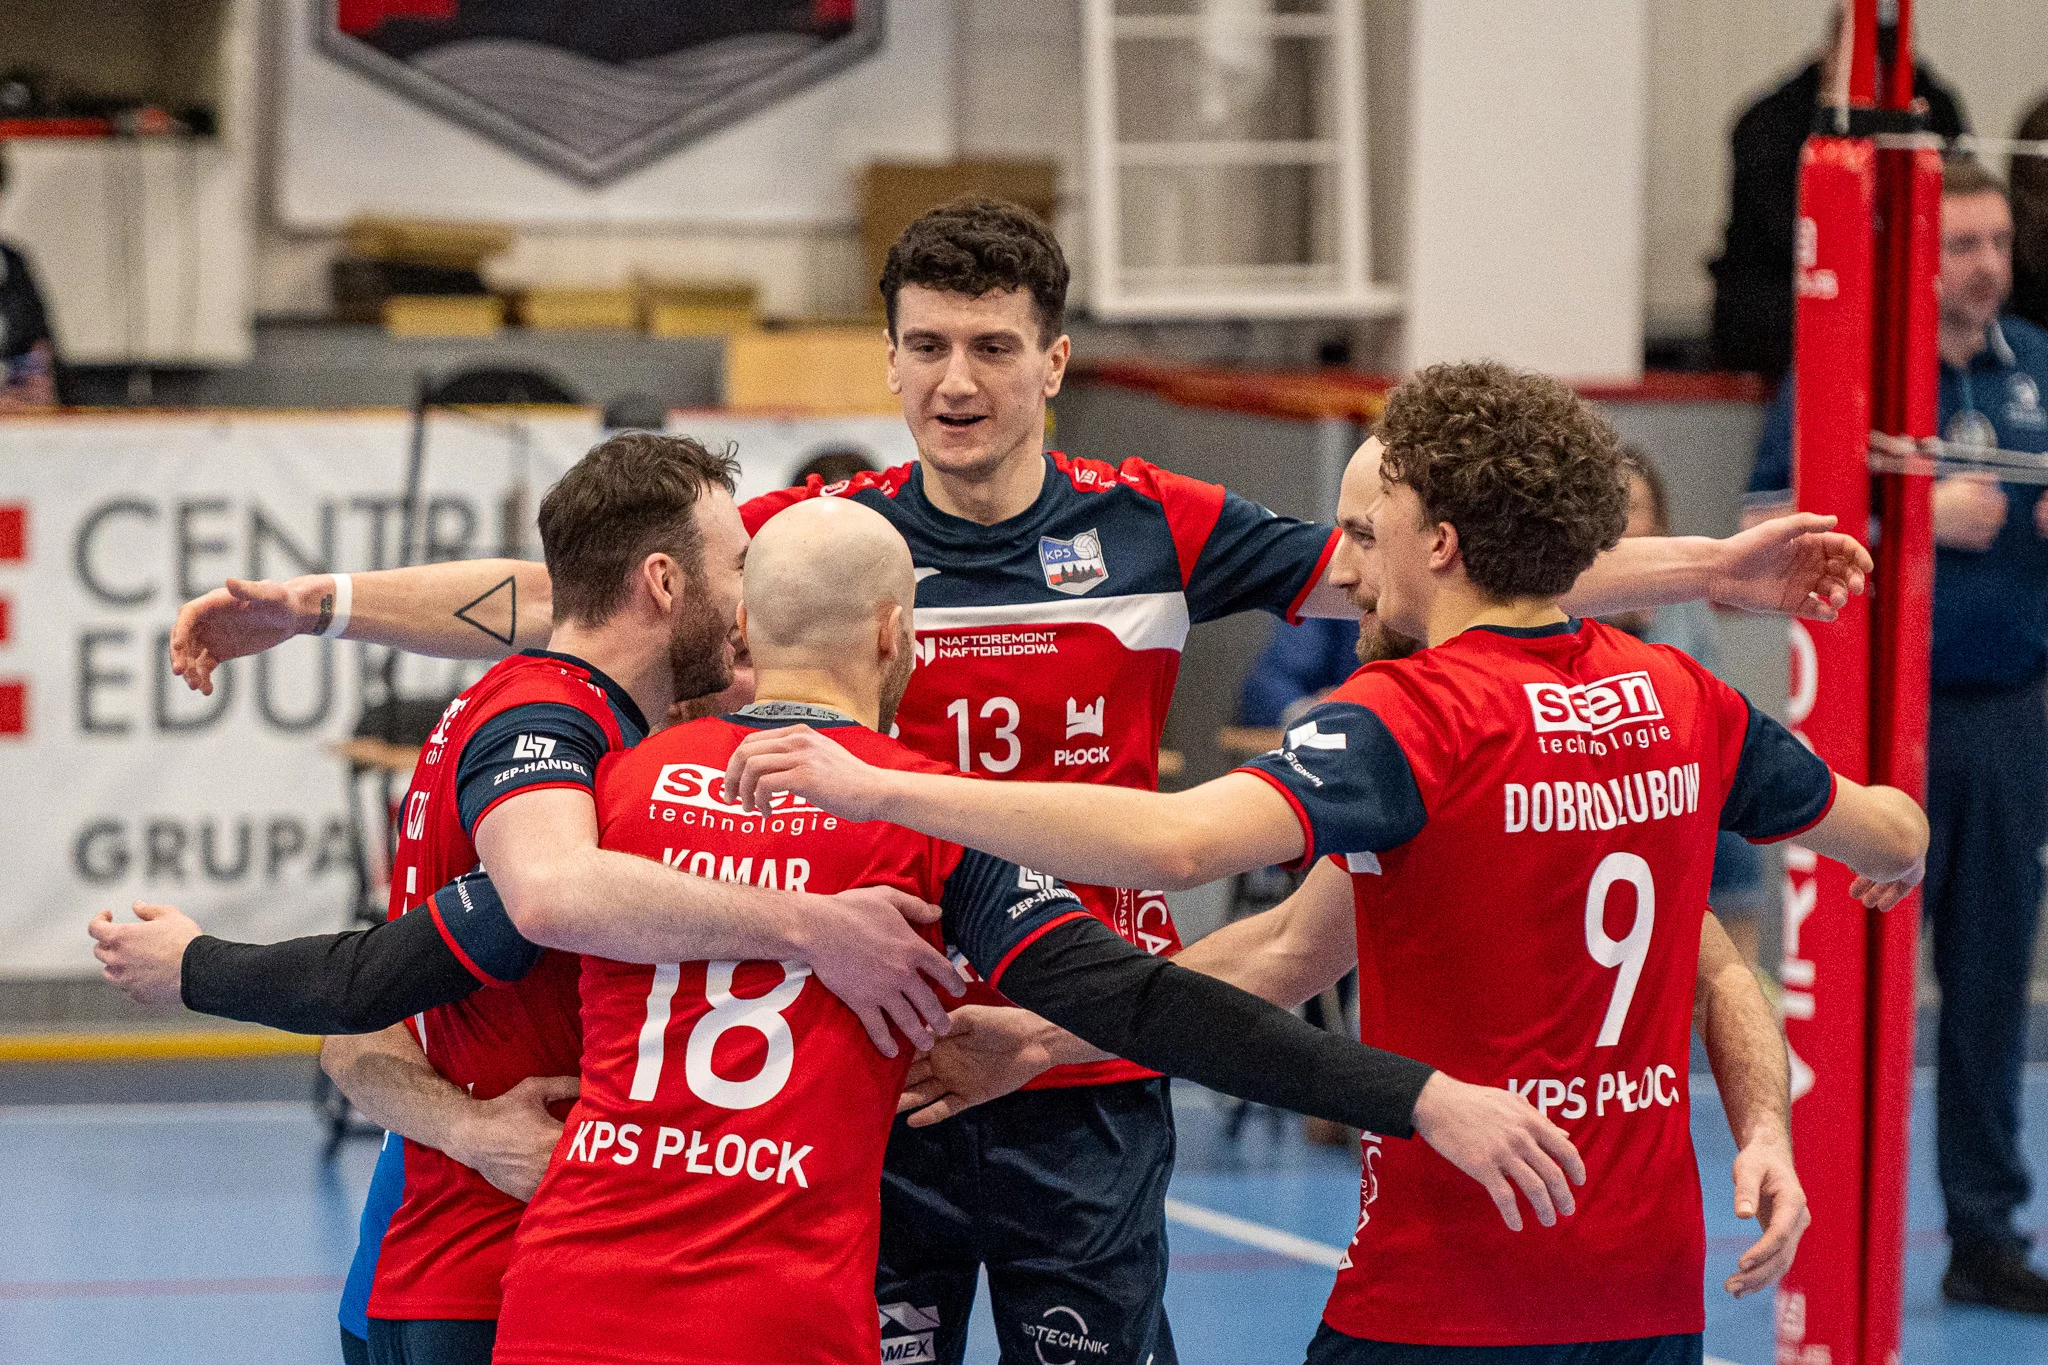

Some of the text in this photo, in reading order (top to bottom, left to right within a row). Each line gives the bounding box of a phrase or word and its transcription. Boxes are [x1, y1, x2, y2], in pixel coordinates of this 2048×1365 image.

[1045, 547, 1072, 561] KPS
[939, 631, 1057, 647] NAFTOREMONT
[939, 643, 1059, 659] NAFTOBUDOWA
[946, 695, 1022, 774] 13
[1538, 721, 1672, 757] technologie
[493, 758, 588, 786] ZEP-HANDEL
[1054, 746, 1110, 766] PŁOCK
[648, 803, 838, 836] technologie
[1006, 888, 1081, 920] ZEP-HAND
[1584, 851, 1656, 1047] 9
[628, 961, 812, 1111] 18
[1596, 1063, 1680, 1118] PŁOC
[566, 1121, 814, 1189] KPS PŁOCK
[881, 1338, 930, 1362] MEX
